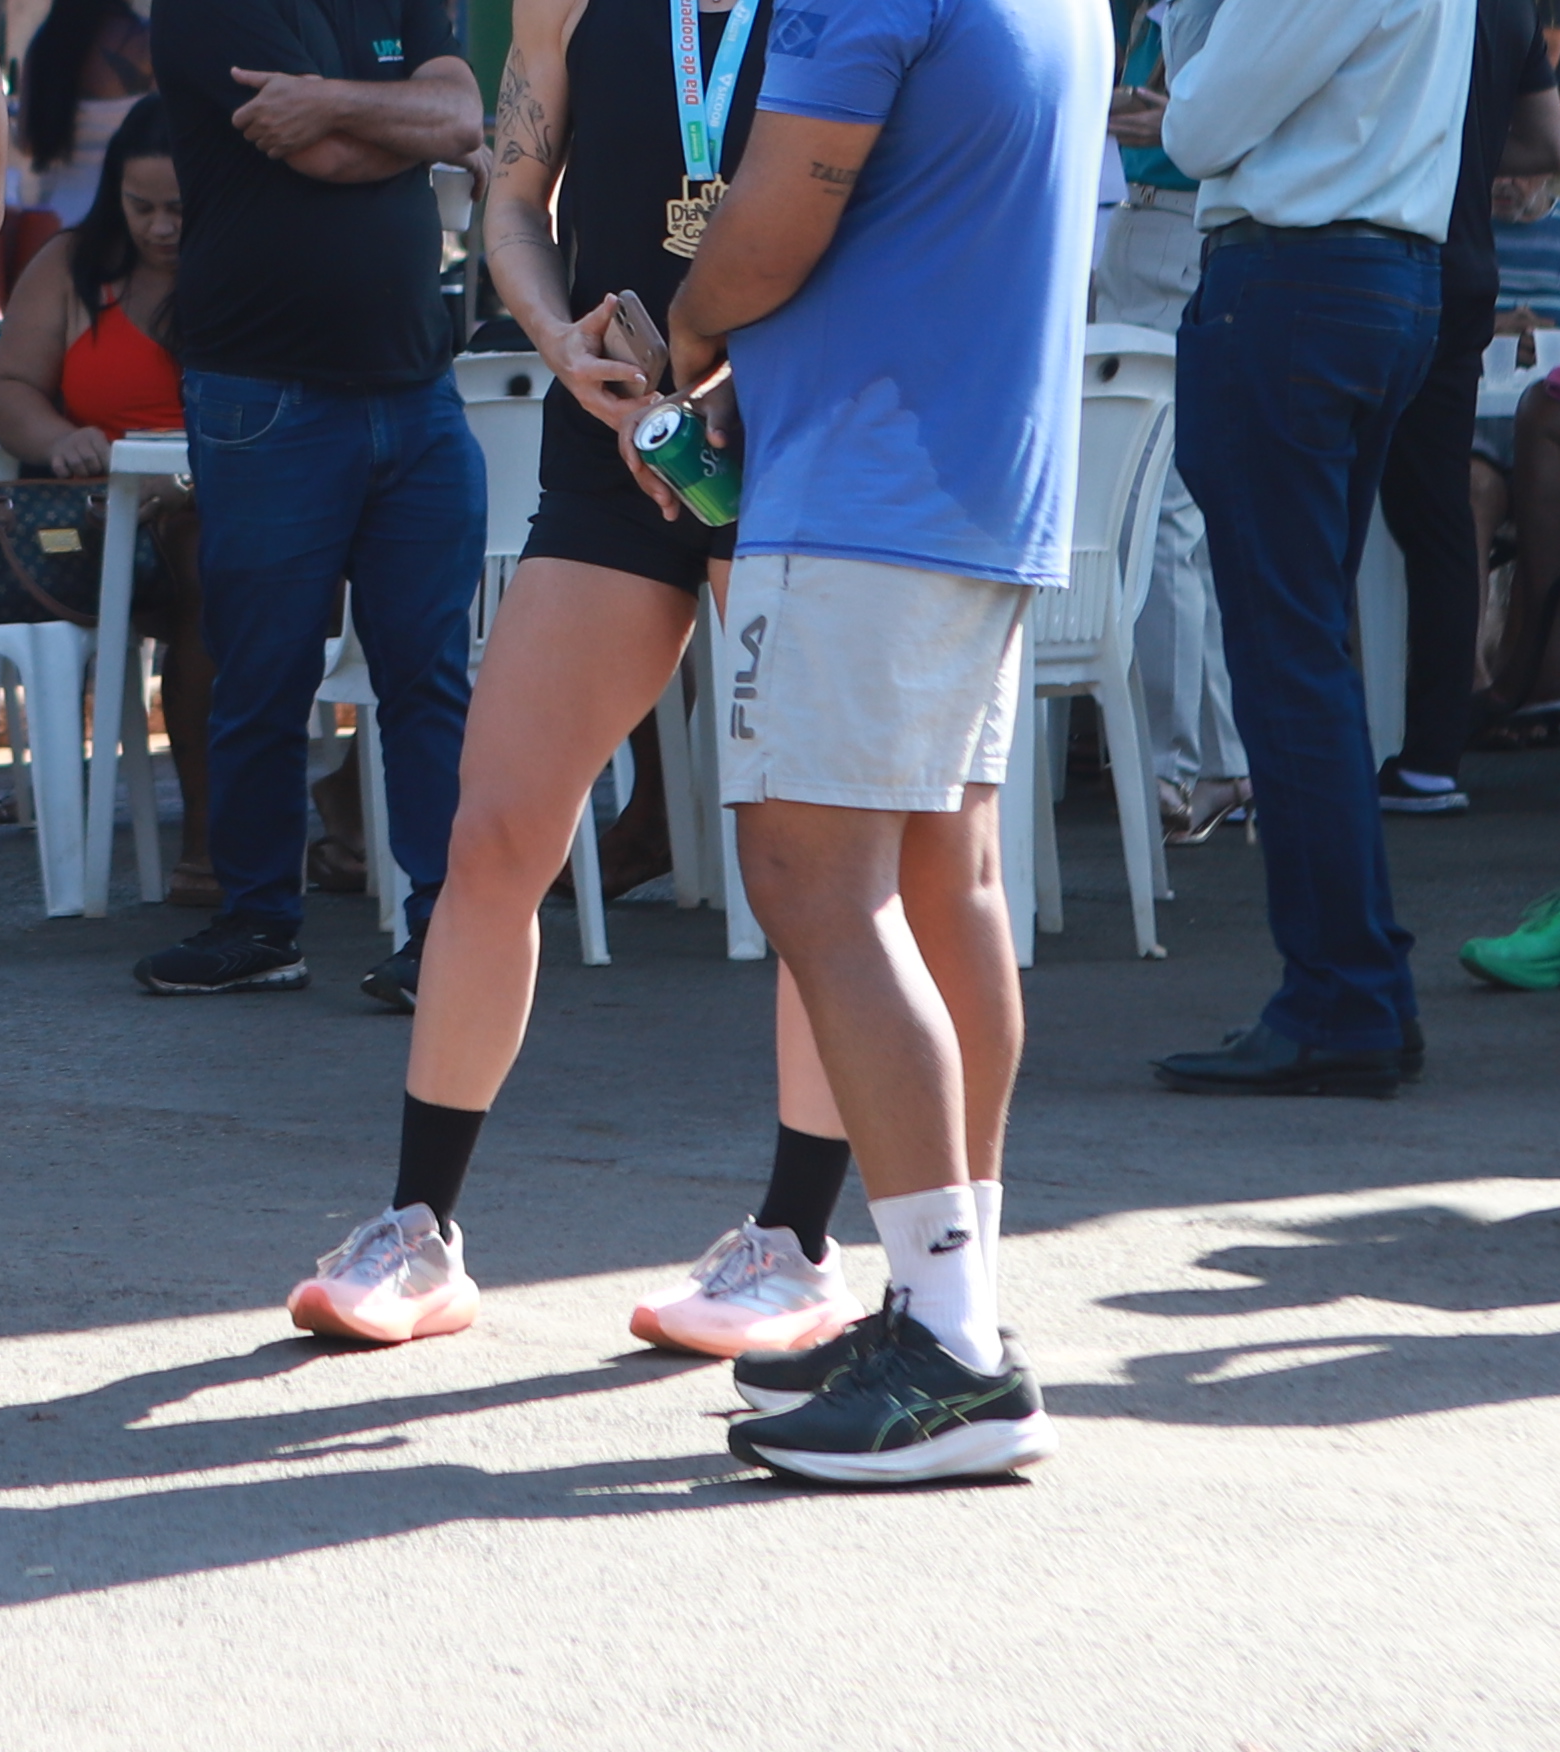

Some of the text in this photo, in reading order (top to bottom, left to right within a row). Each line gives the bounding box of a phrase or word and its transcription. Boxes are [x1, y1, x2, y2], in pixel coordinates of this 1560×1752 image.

[679, 56, 696, 75] de
[682, 80, 699, 106] Dia
[672, 204, 699, 223] Dia
[730, 614, 767, 741] FILA
